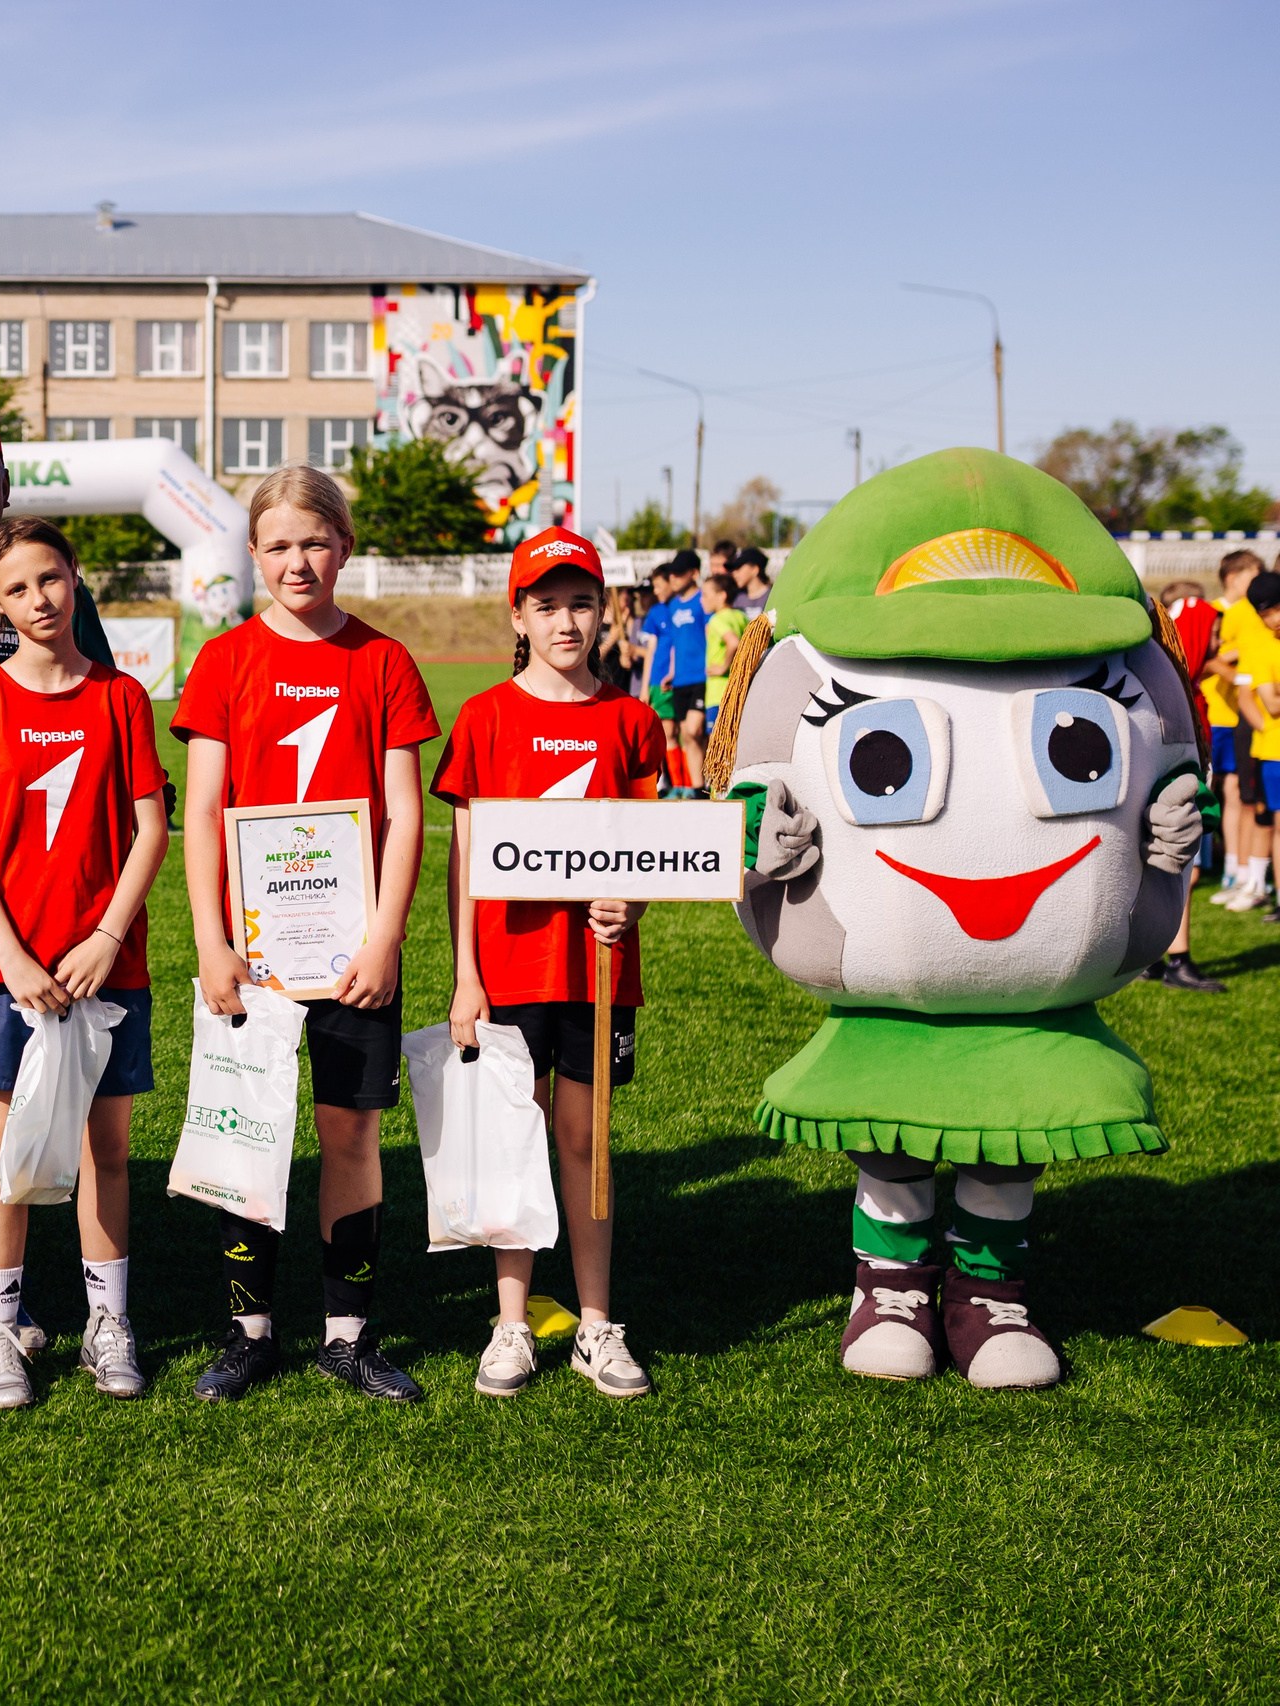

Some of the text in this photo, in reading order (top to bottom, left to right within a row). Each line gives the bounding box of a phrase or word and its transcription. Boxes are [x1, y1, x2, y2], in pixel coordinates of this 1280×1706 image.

[276, 683, 339, 700] Первые
[21, 729, 84, 746] Первые
[533, 737, 597, 755] Первые
[284, 859, 315, 873] 2025
[492, 841, 721, 879] Остроленка
[266, 877, 338, 894] ДИПЛОМ
[280, 892, 326, 901] УЧАСТНИКА
[191, 1184, 246, 1203] METROSHKA.RU
[224, 1250, 256, 1262] DEMIX
